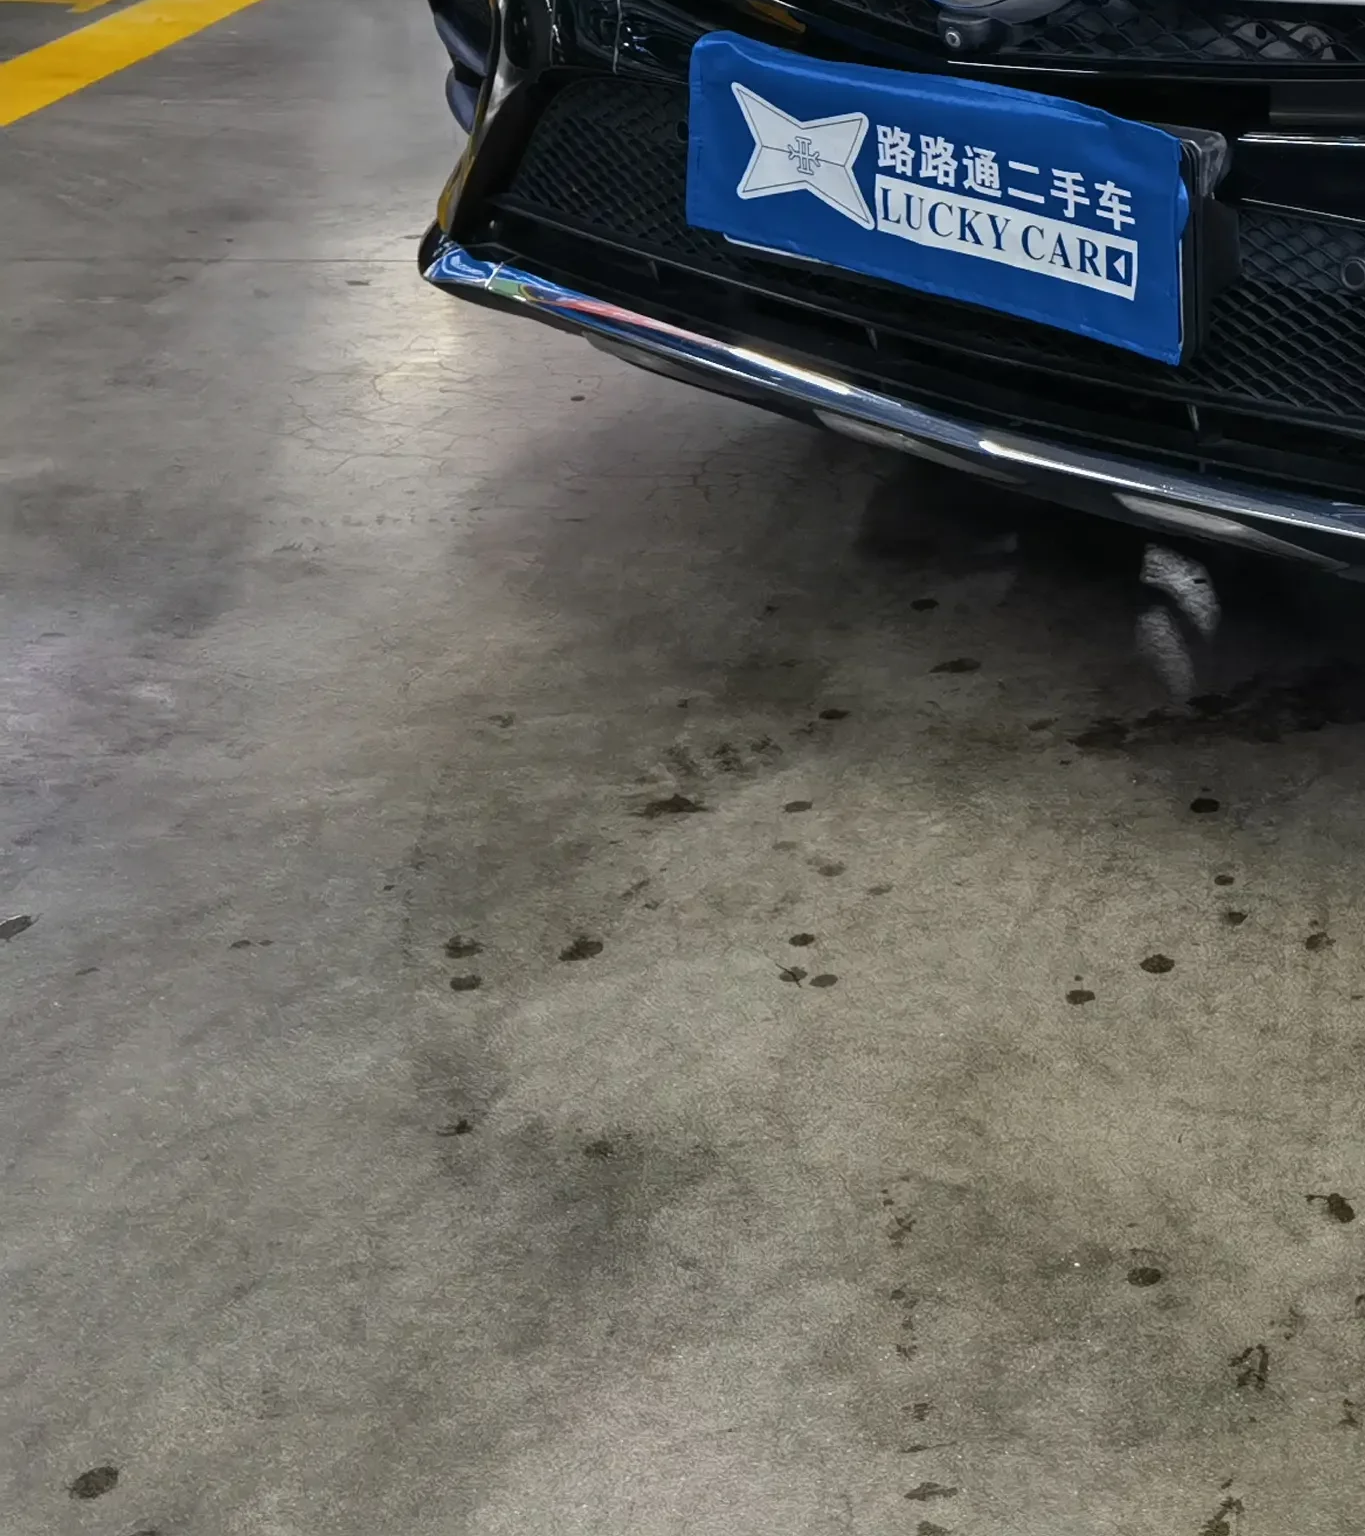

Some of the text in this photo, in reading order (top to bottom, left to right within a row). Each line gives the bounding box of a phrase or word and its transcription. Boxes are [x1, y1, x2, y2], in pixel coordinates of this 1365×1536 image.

[876, 125, 1136, 231] 路路通二手车
[880, 187, 1102, 277] LUCKY CAR
